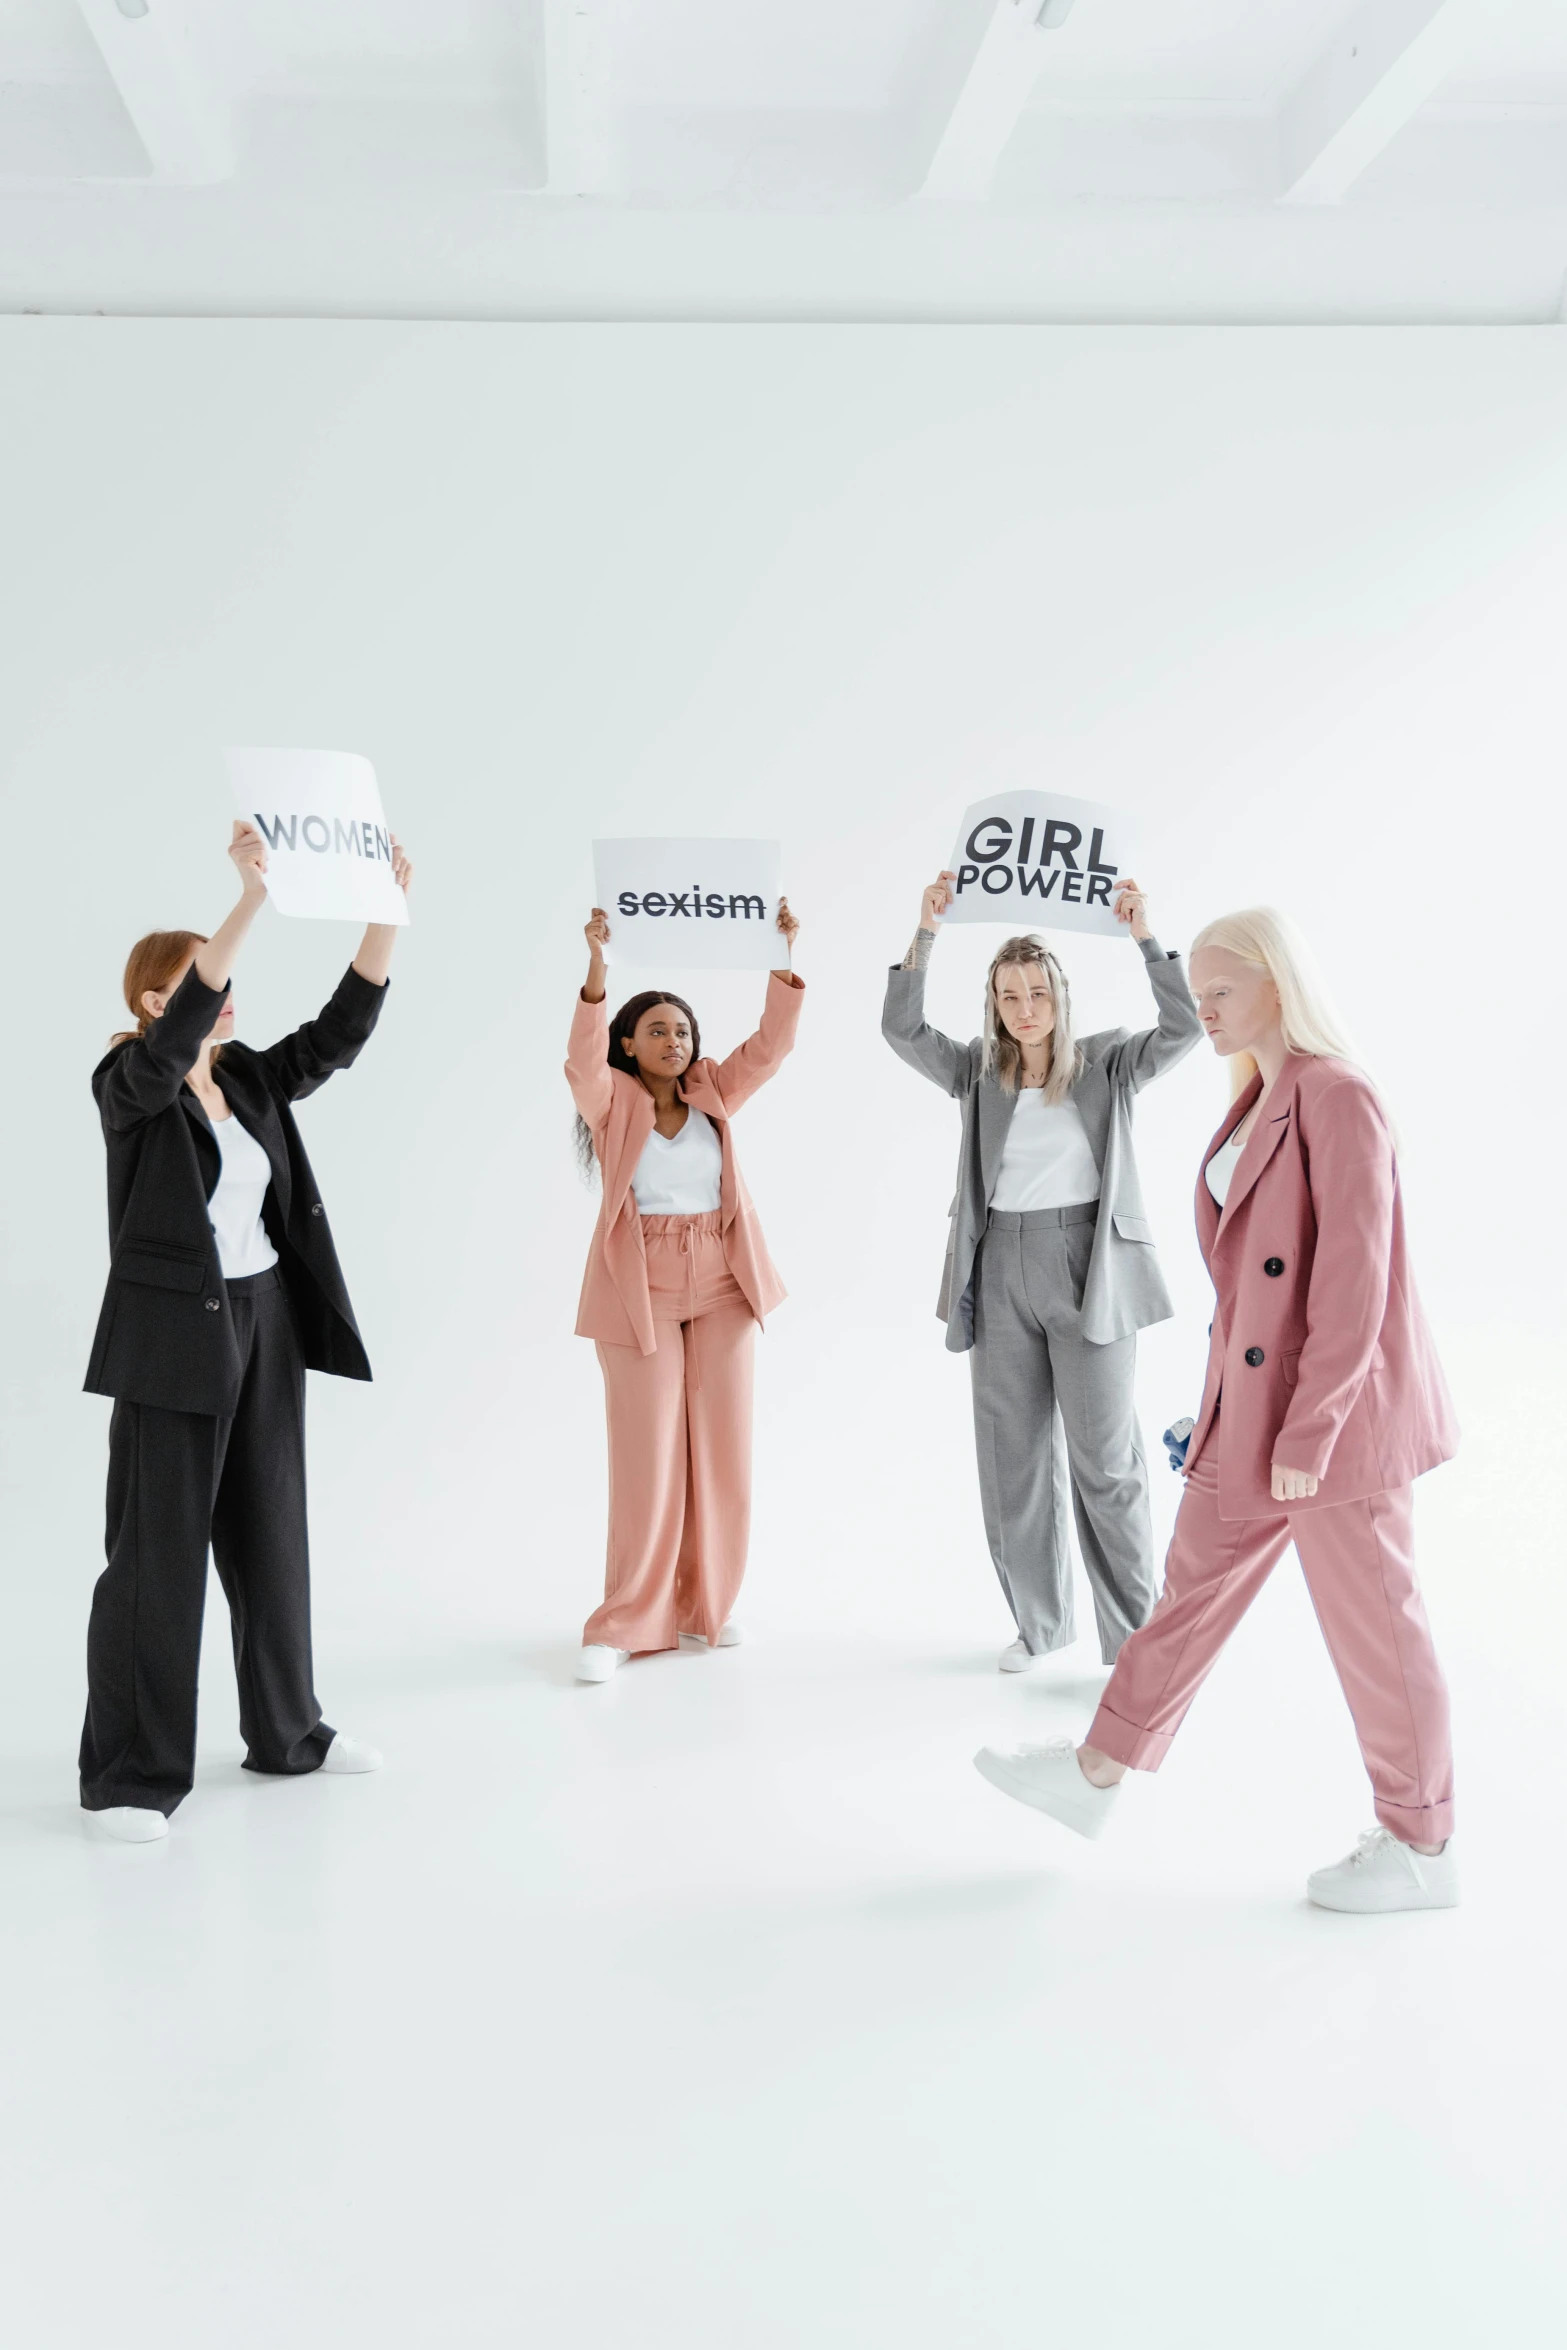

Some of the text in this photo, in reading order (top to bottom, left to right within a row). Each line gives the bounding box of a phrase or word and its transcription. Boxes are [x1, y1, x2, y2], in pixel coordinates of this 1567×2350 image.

[253, 813, 392, 862] WOMEN
[965, 816, 1118, 876] GIRL
[617, 884, 766, 920] sexism
[956, 864, 1113, 907] POWER
